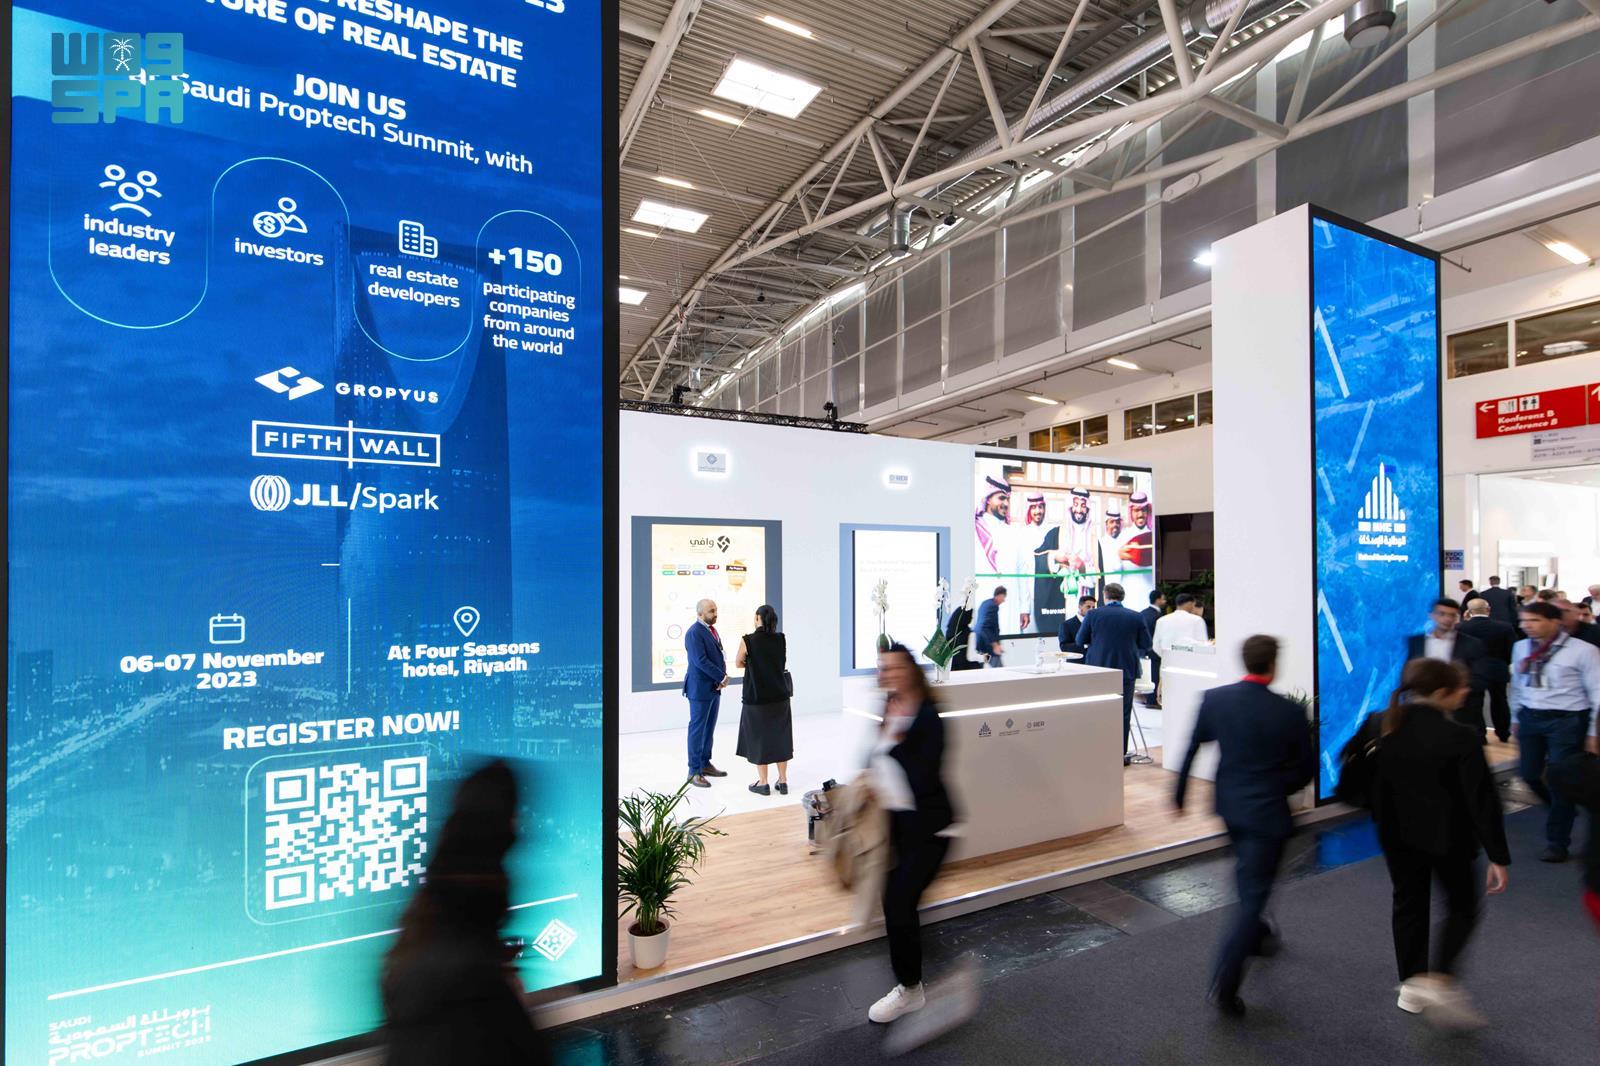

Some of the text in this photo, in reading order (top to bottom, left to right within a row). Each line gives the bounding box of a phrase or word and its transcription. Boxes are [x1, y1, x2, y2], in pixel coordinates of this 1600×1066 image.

[294, 7, 336, 35] OF
[343, 19, 417, 60] REAL
[422, 43, 518, 88] ESTATE
[473, 27, 523, 61] THE
[293, 73, 407, 121] JOIN US
[260, 92, 376, 138] Proptech
[383, 122, 480, 165] Summit,
[485, 150, 533, 174] with
[83, 213, 176, 247] industry
[89, 237, 171, 265] leaders
[234, 237, 324, 266] investors
[488, 247, 563, 276] +150
[369, 263, 459, 288] real estate
[367, 281, 460, 308] developers
[483, 281, 576, 310] participating
[489, 300, 570, 322] companies
[483, 314, 575, 340] from around
[492, 334, 563, 355] the world
[335, 382, 439, 404] GROPYUS
[1497, 410, 1555, 424] Konferenz B
[1497, 418, 1558, 433] Conference B
[264, 431, 431, 457] FIFTH WALL
[120, 648, 325, 674] 06-07 November
[387, 641, 540, 660] At Four Seasons
[196, 670, 257, 690] 2023
[402, 656, 528, 678] hotel, Riyadh
[223, 710, 460, 750] REGISTER NOW!
[49, 1015, 92, 1031] SAUDI
[48, 1016, 212, 1066] PROPTECH
[137, 1042, 181, 1058] SUMMIT
